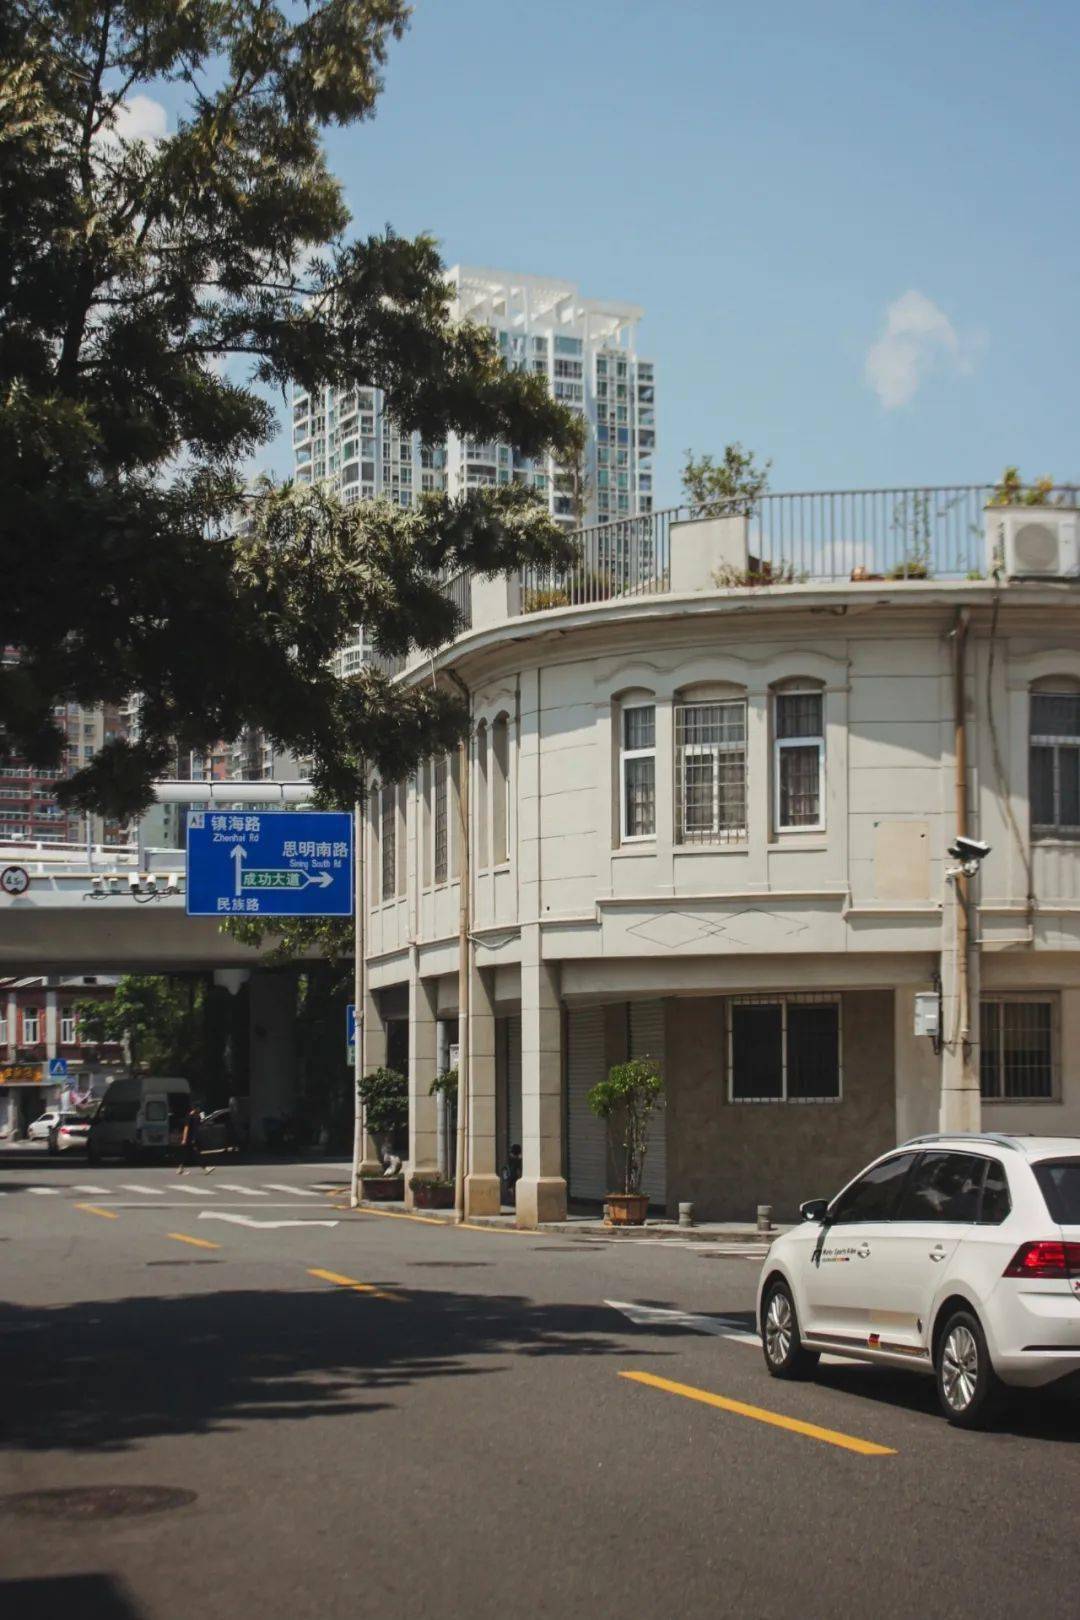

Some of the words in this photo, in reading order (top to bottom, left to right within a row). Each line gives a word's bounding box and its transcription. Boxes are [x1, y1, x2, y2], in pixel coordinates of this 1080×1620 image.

[211, 815, 261, 832] 镇海路
[213, 833, 246, 842] Zhenhai
[249, 833, 259, 842] Rd
[282, 841, 349, 858] 思明南路
[312, 859, 331, 868] South
[243, 873, 300, 887] 成功大道
[217, 897, 260, 911] 民族路
